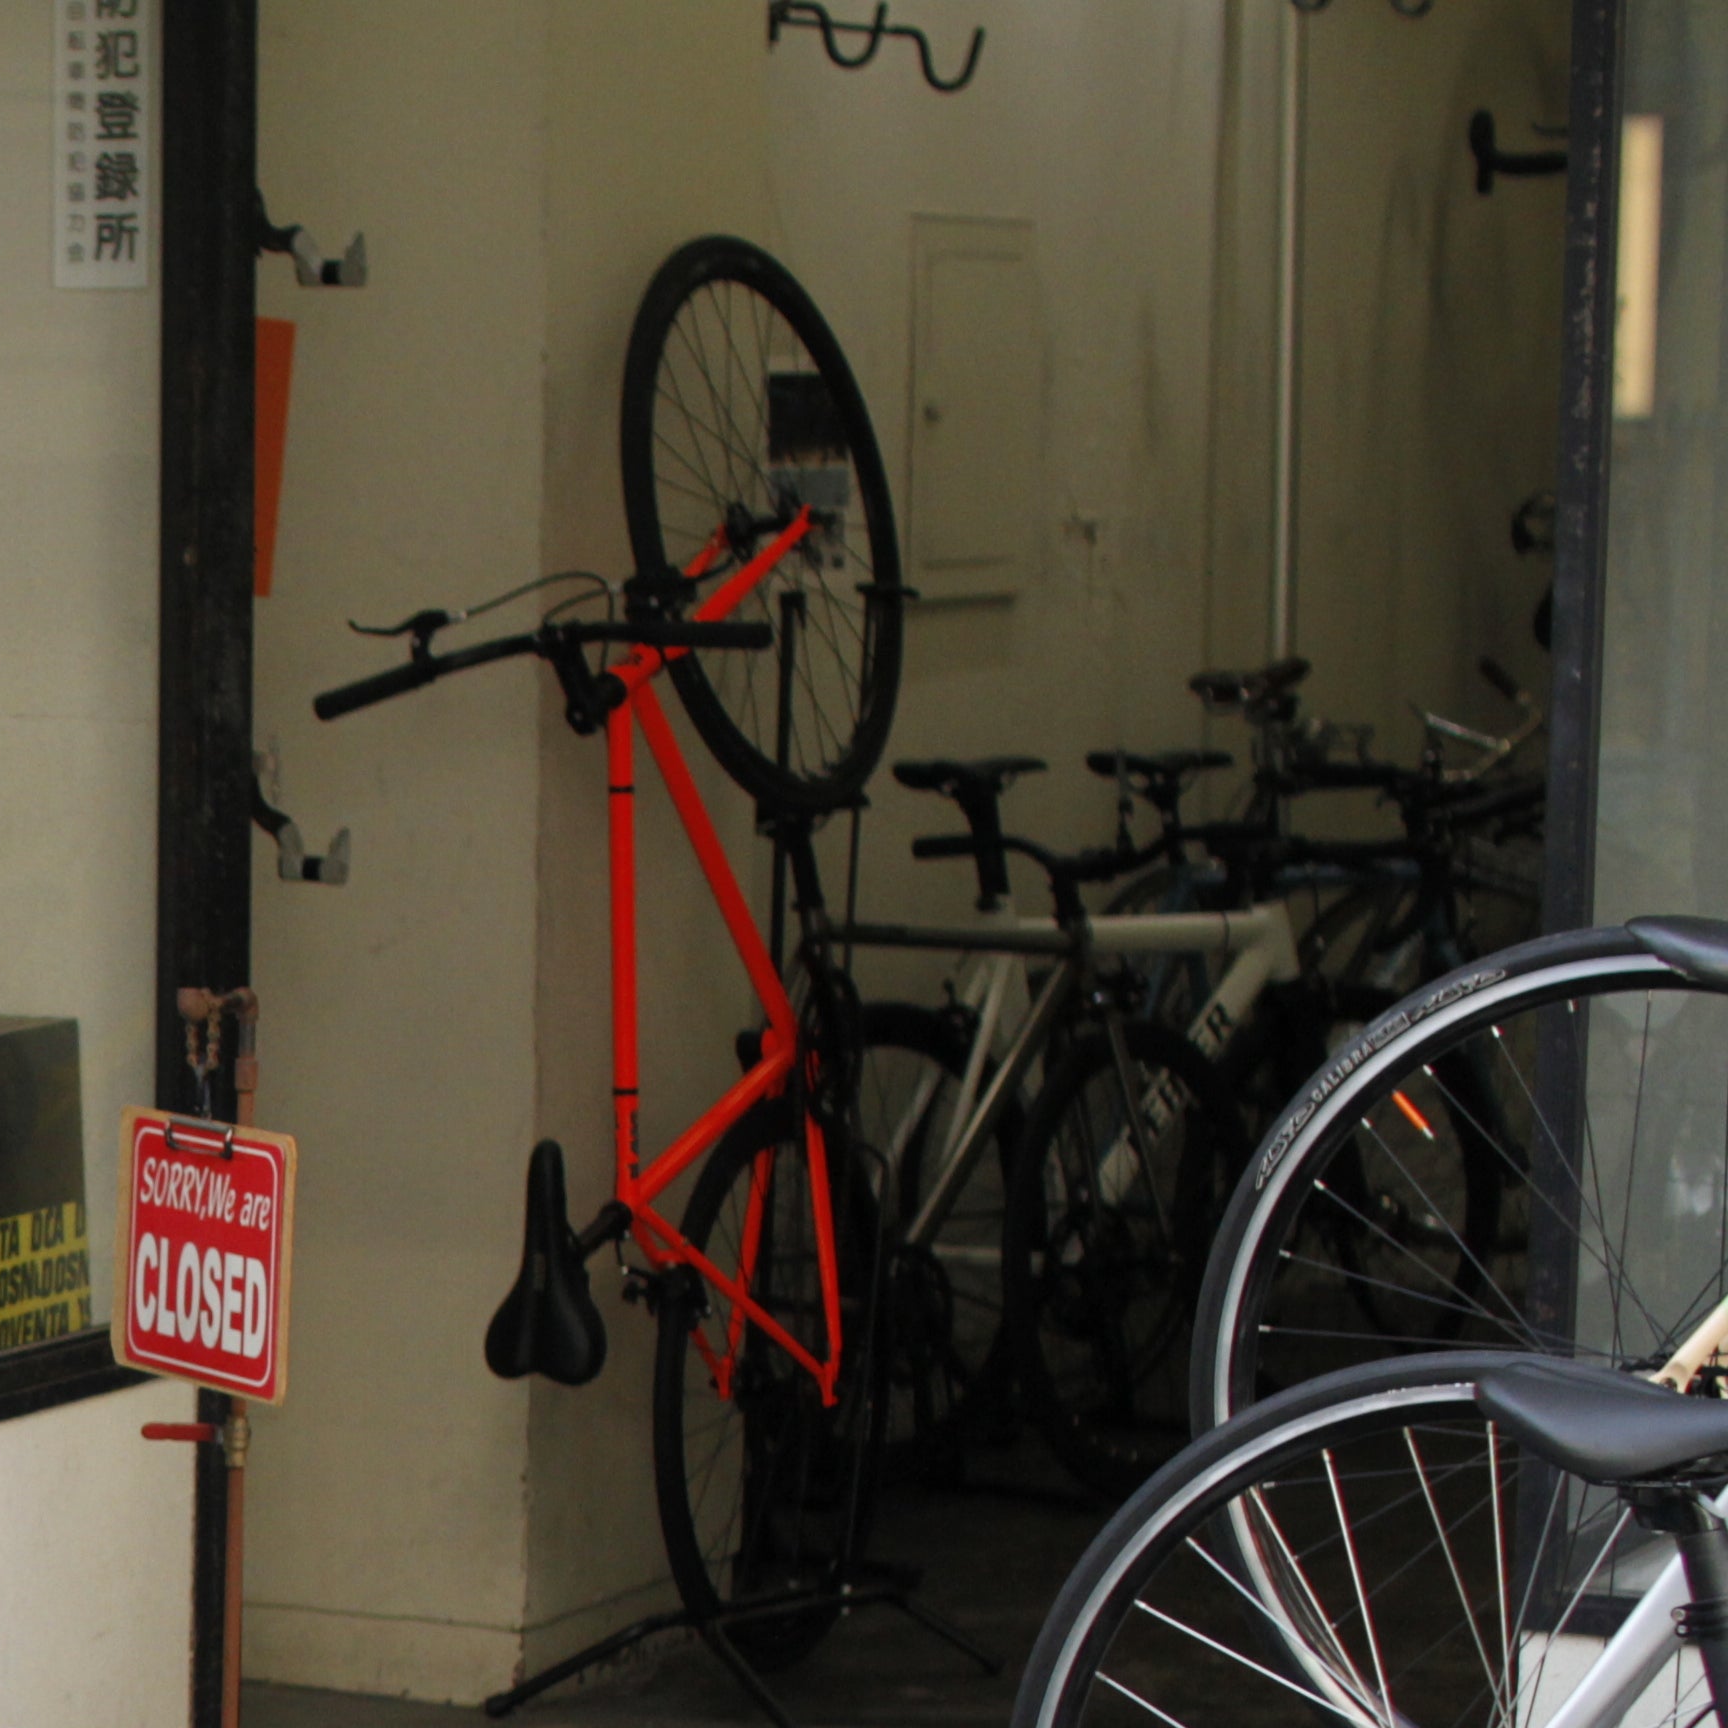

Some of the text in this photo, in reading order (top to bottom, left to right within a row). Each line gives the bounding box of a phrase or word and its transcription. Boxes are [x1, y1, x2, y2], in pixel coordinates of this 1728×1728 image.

[1310, 1037, 1373, 1105] CALIBRA
[239, 1191, 271, 1231] are
[135, 1232, 268, 1359] CLOSED
